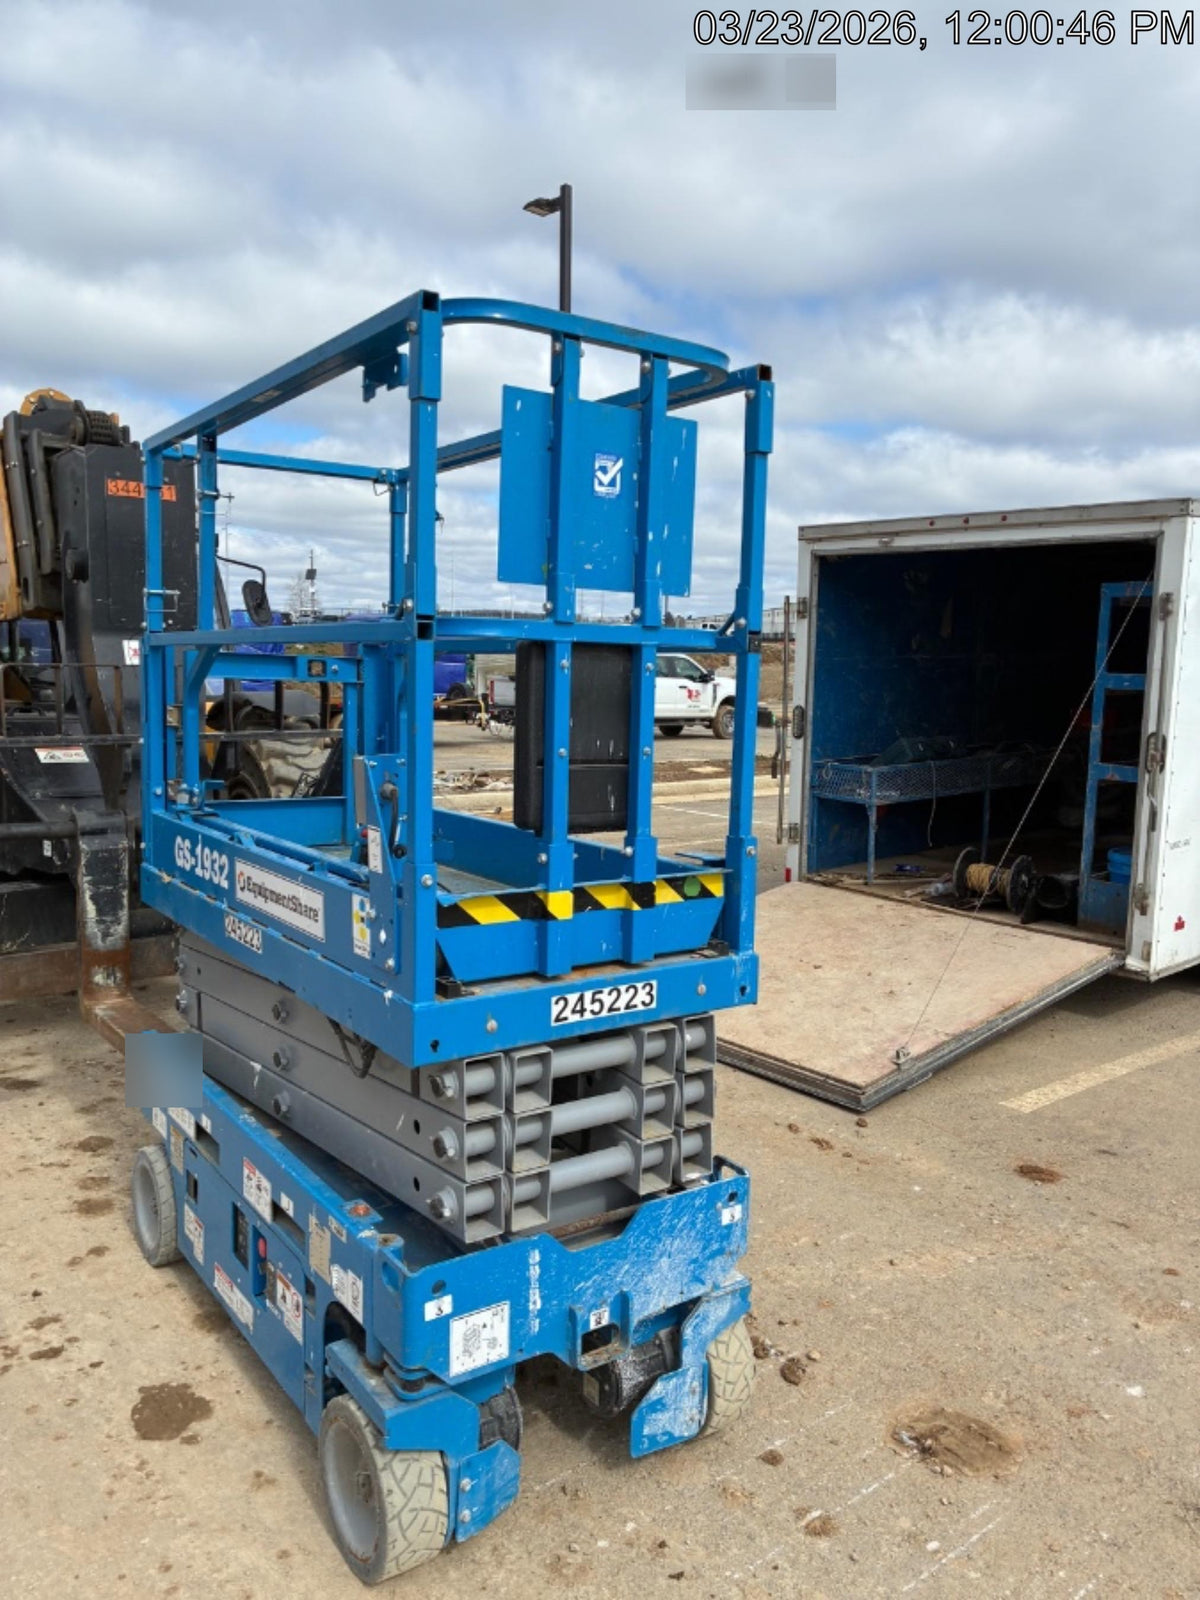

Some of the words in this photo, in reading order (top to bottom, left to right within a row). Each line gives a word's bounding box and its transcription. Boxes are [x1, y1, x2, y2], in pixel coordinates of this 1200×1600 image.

[109, 480, 174, 500] 3441
[175, 835, 229, 889] GS-1932
[245, 875, 320, 924] EquipmentShare
[225, 914, 263, 952] 245223
[553, 981, 655, 1024] 245223
